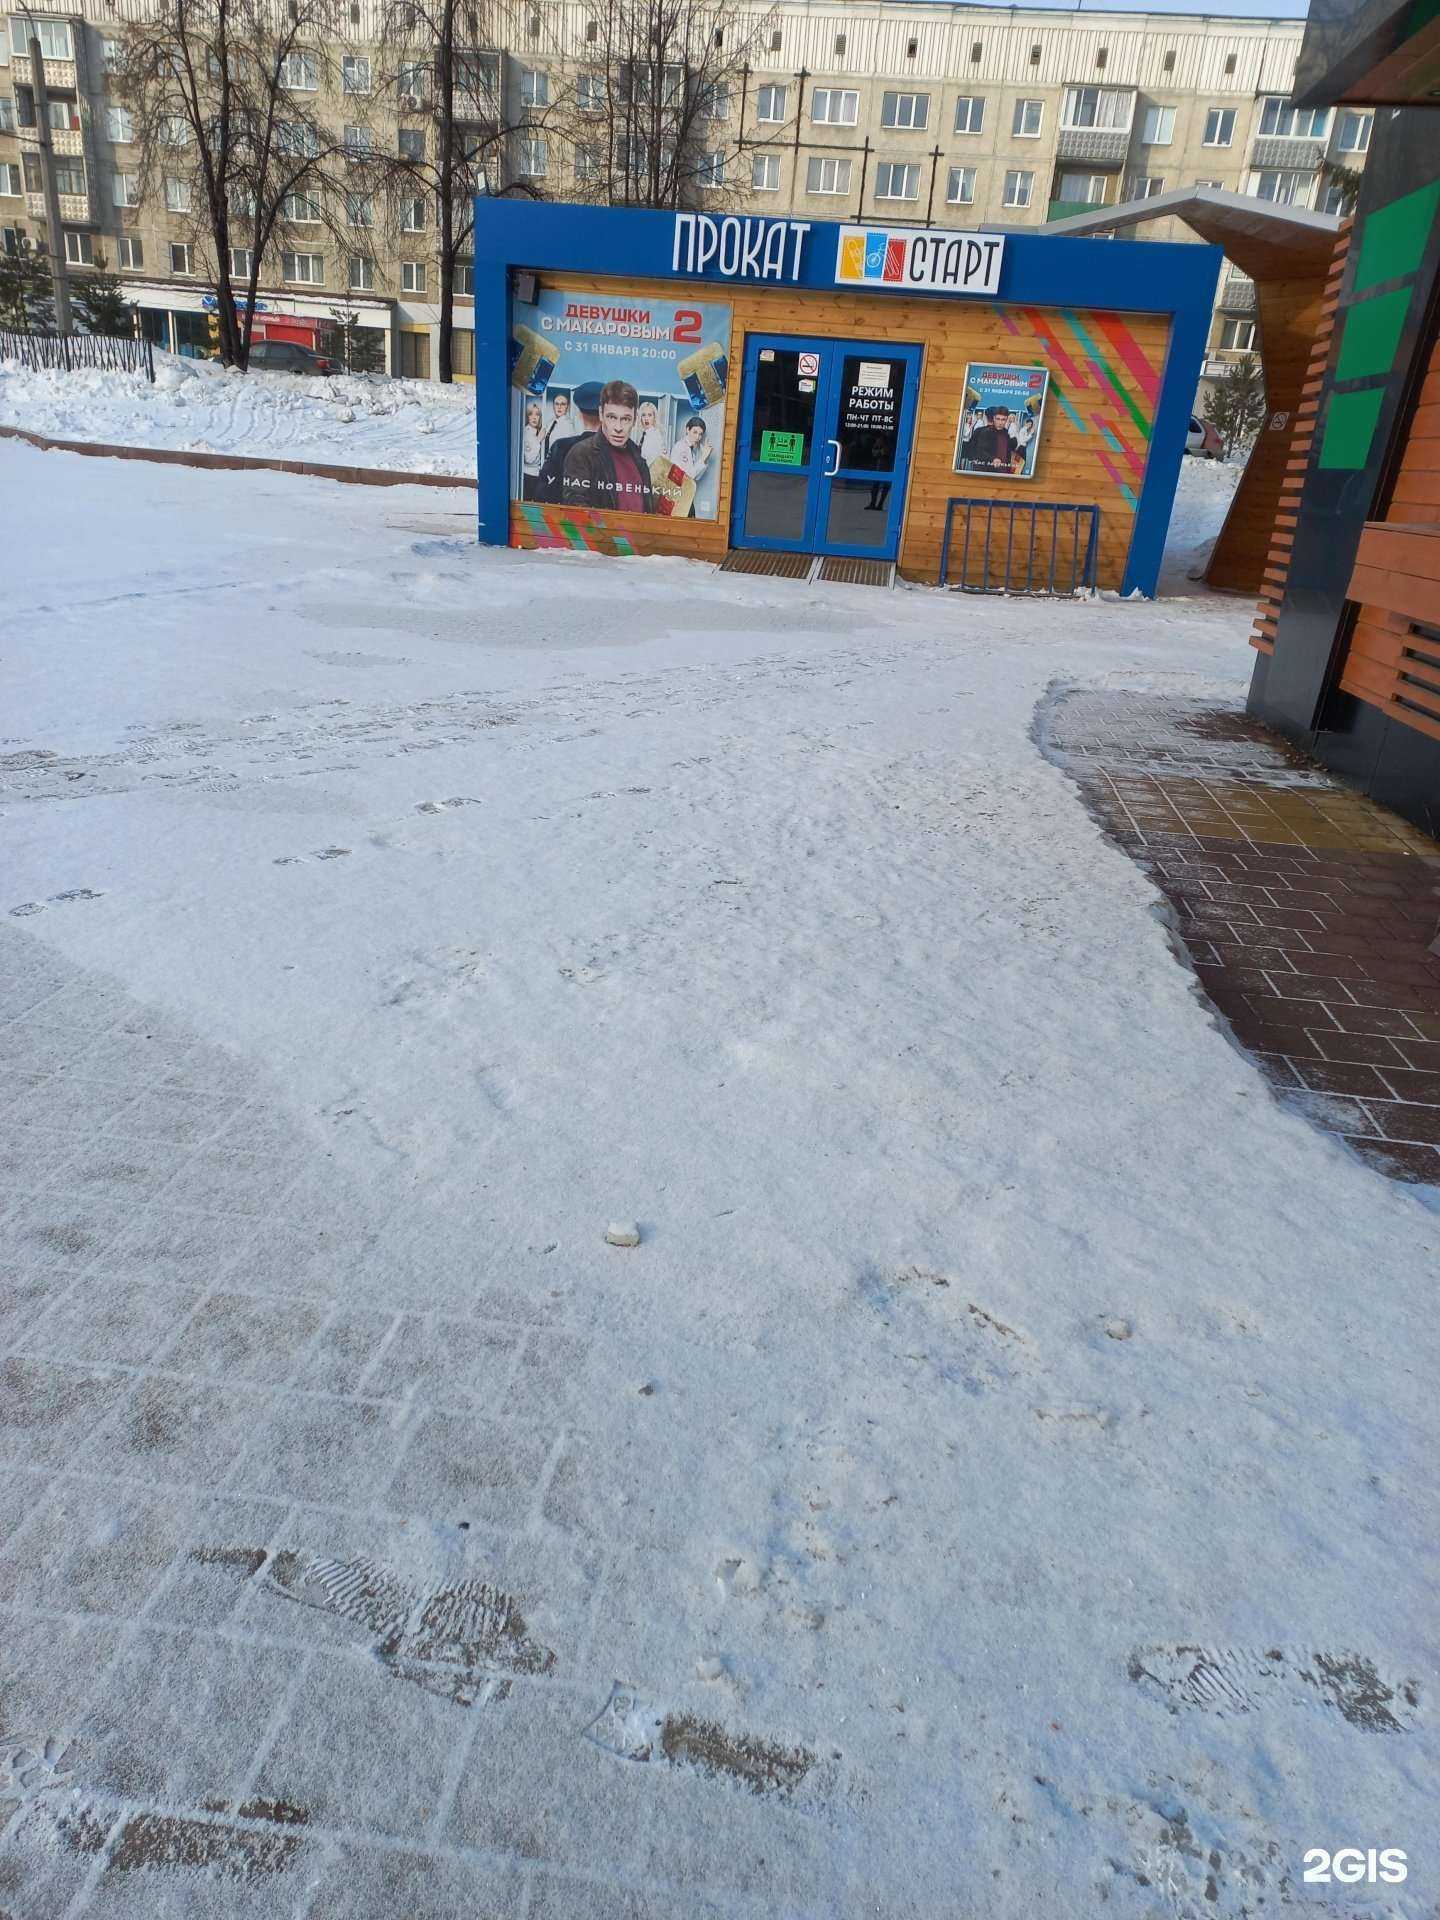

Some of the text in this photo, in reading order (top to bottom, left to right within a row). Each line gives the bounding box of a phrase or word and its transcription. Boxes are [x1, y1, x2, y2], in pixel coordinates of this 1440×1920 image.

[672, 213, 811, 281] ПРОКАТ
[909, 236, 1000, 287] СТАРТ
[566, 303, 651, 324] ДЕВУШКИ
[541, 309, 703, 344] С МАКАРОВЫМ 2
[564, 340, 677, 360] С 31 ЯНВАРЯ 20:00
[851, 385, 894, 398] РЕЖИМ
[849, 398, 894, 411] РАБОТЫ
[846, 413, 869, 421] ПН-ЧТ
[546, 475, 683, 497] У НАС НОВЕНЬКИЙ
